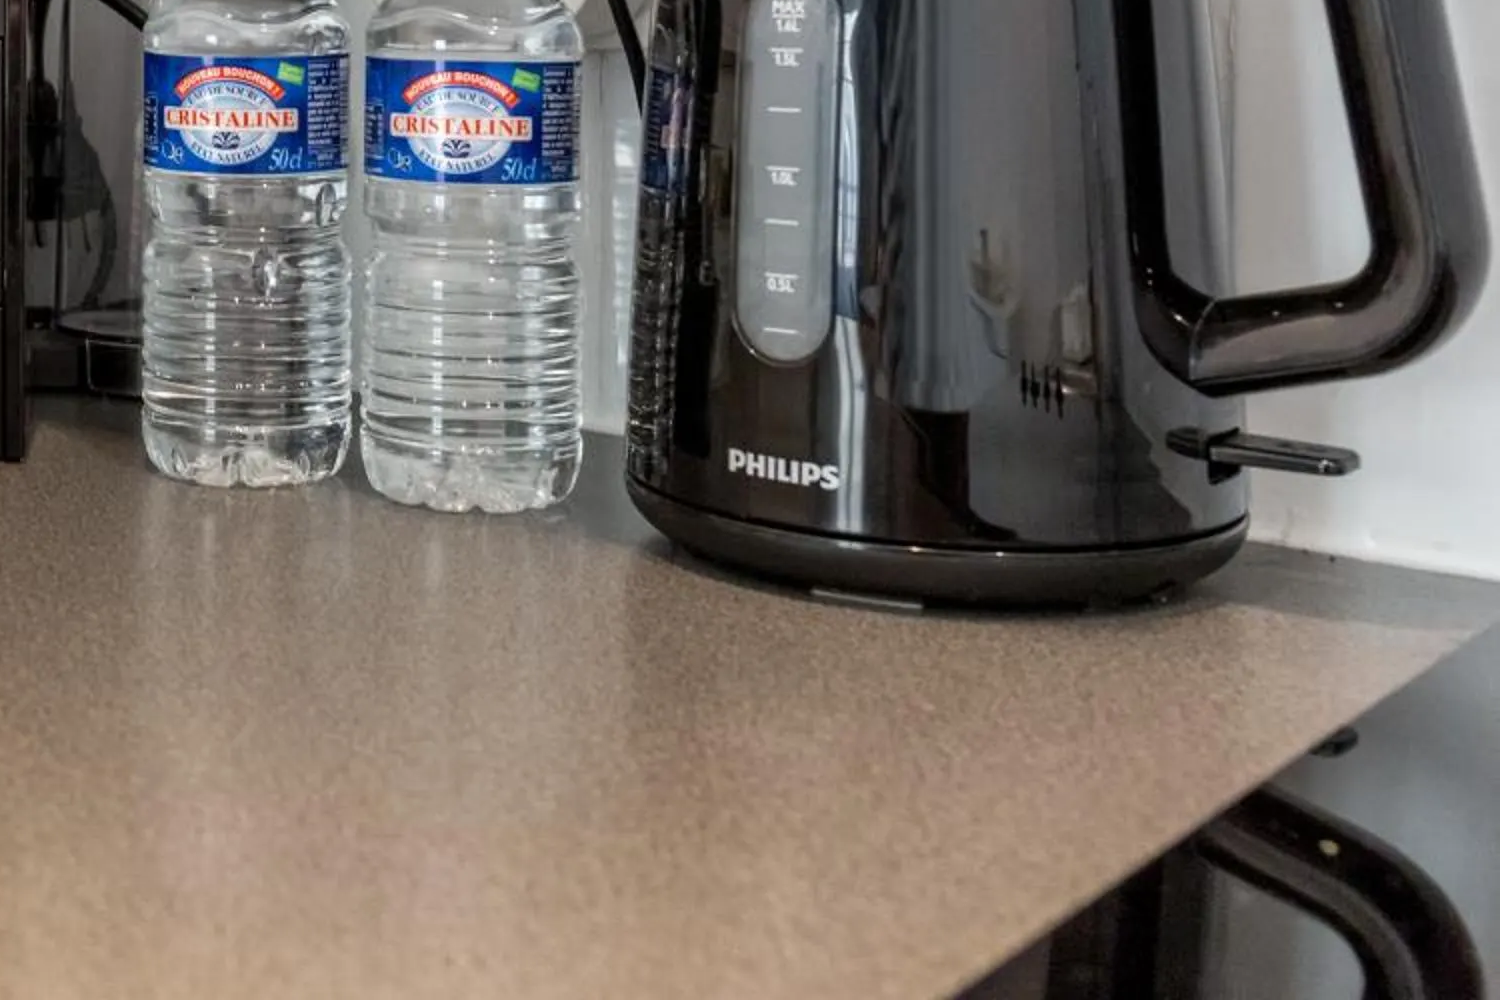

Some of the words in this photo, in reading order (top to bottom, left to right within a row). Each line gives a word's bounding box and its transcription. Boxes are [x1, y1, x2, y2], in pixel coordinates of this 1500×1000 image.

[771, 0, 805, 13] MAX
[166, 109, 295, 128] CRISTALINE
[393, 115, 529, 137] CRISTALINE
[727, 447, 840, 490] PHILIPS
